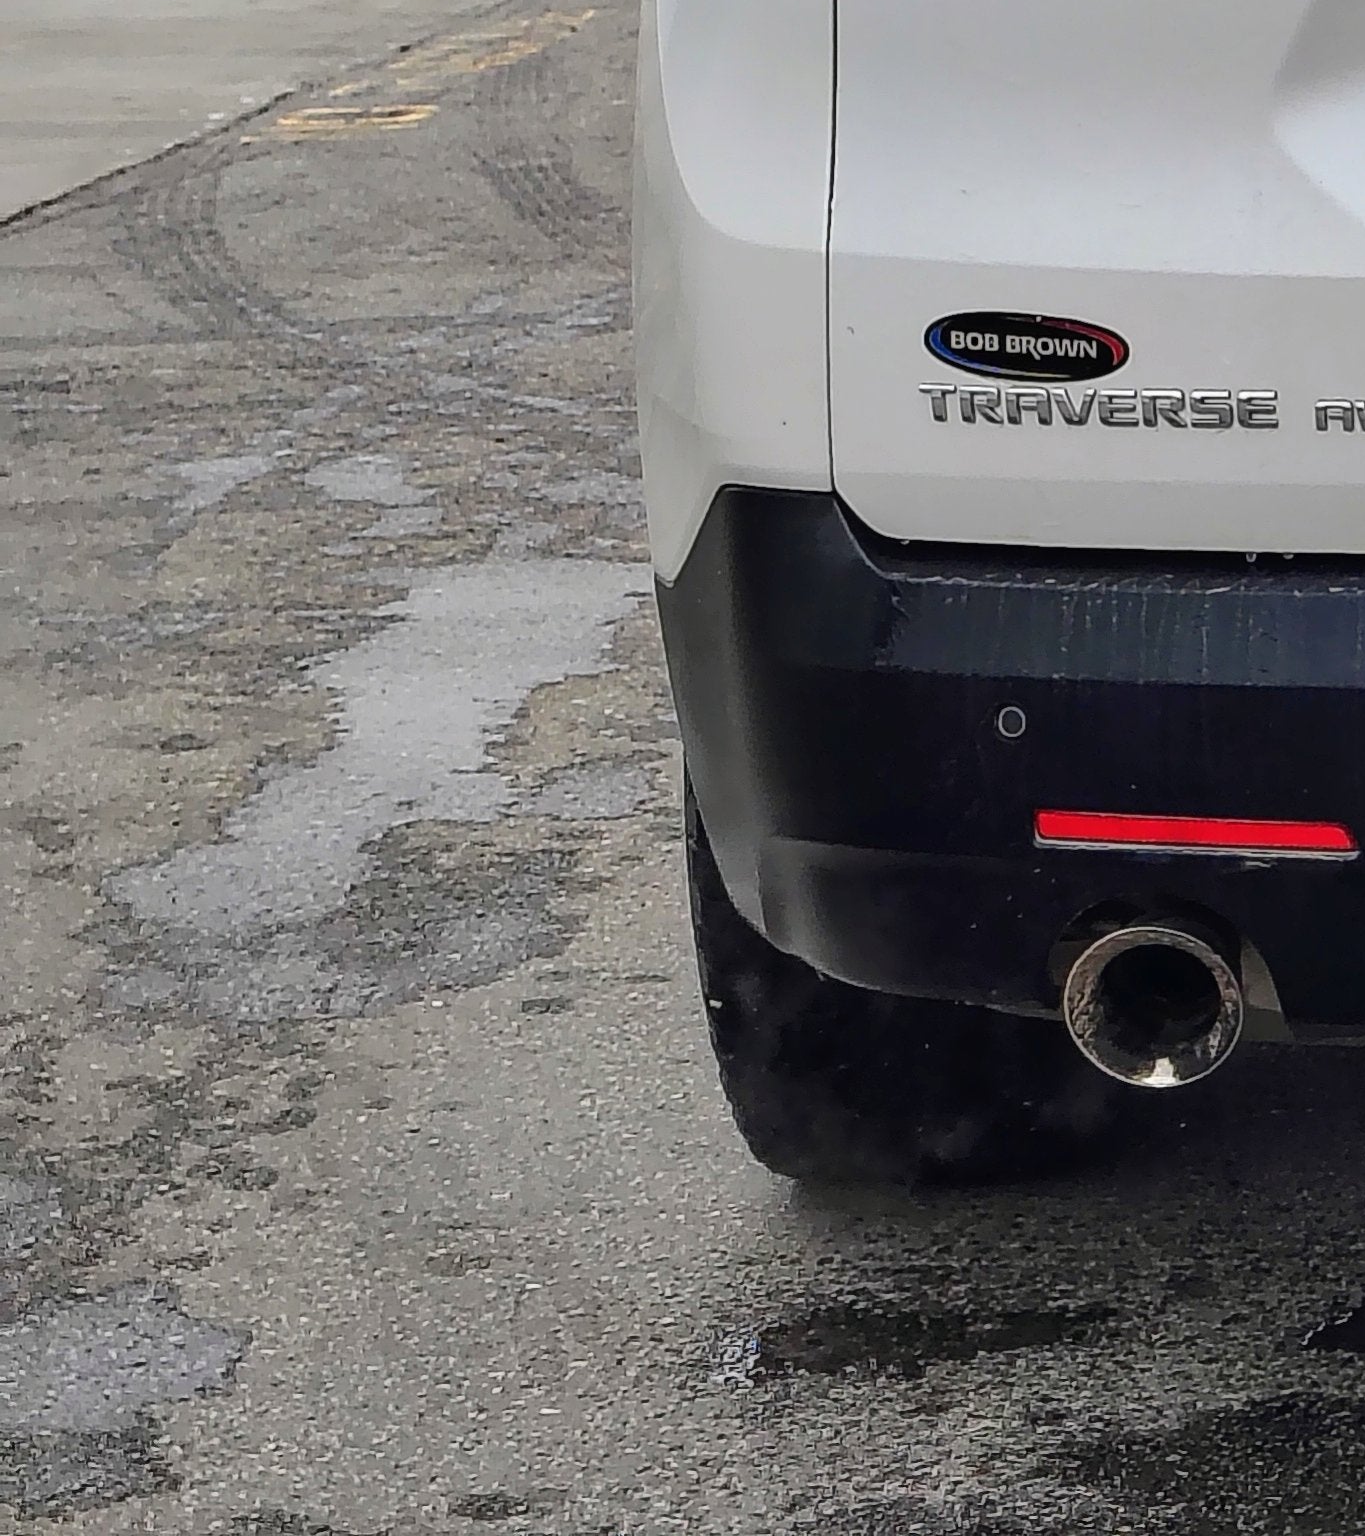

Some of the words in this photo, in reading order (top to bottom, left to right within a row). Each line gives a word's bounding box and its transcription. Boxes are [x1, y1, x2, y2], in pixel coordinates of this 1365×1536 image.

[950, 330, 999, 352] BOB
[1005, 334, 1098, 361] BROWN
[918, 382, 1279, 429] TRAVERSE
